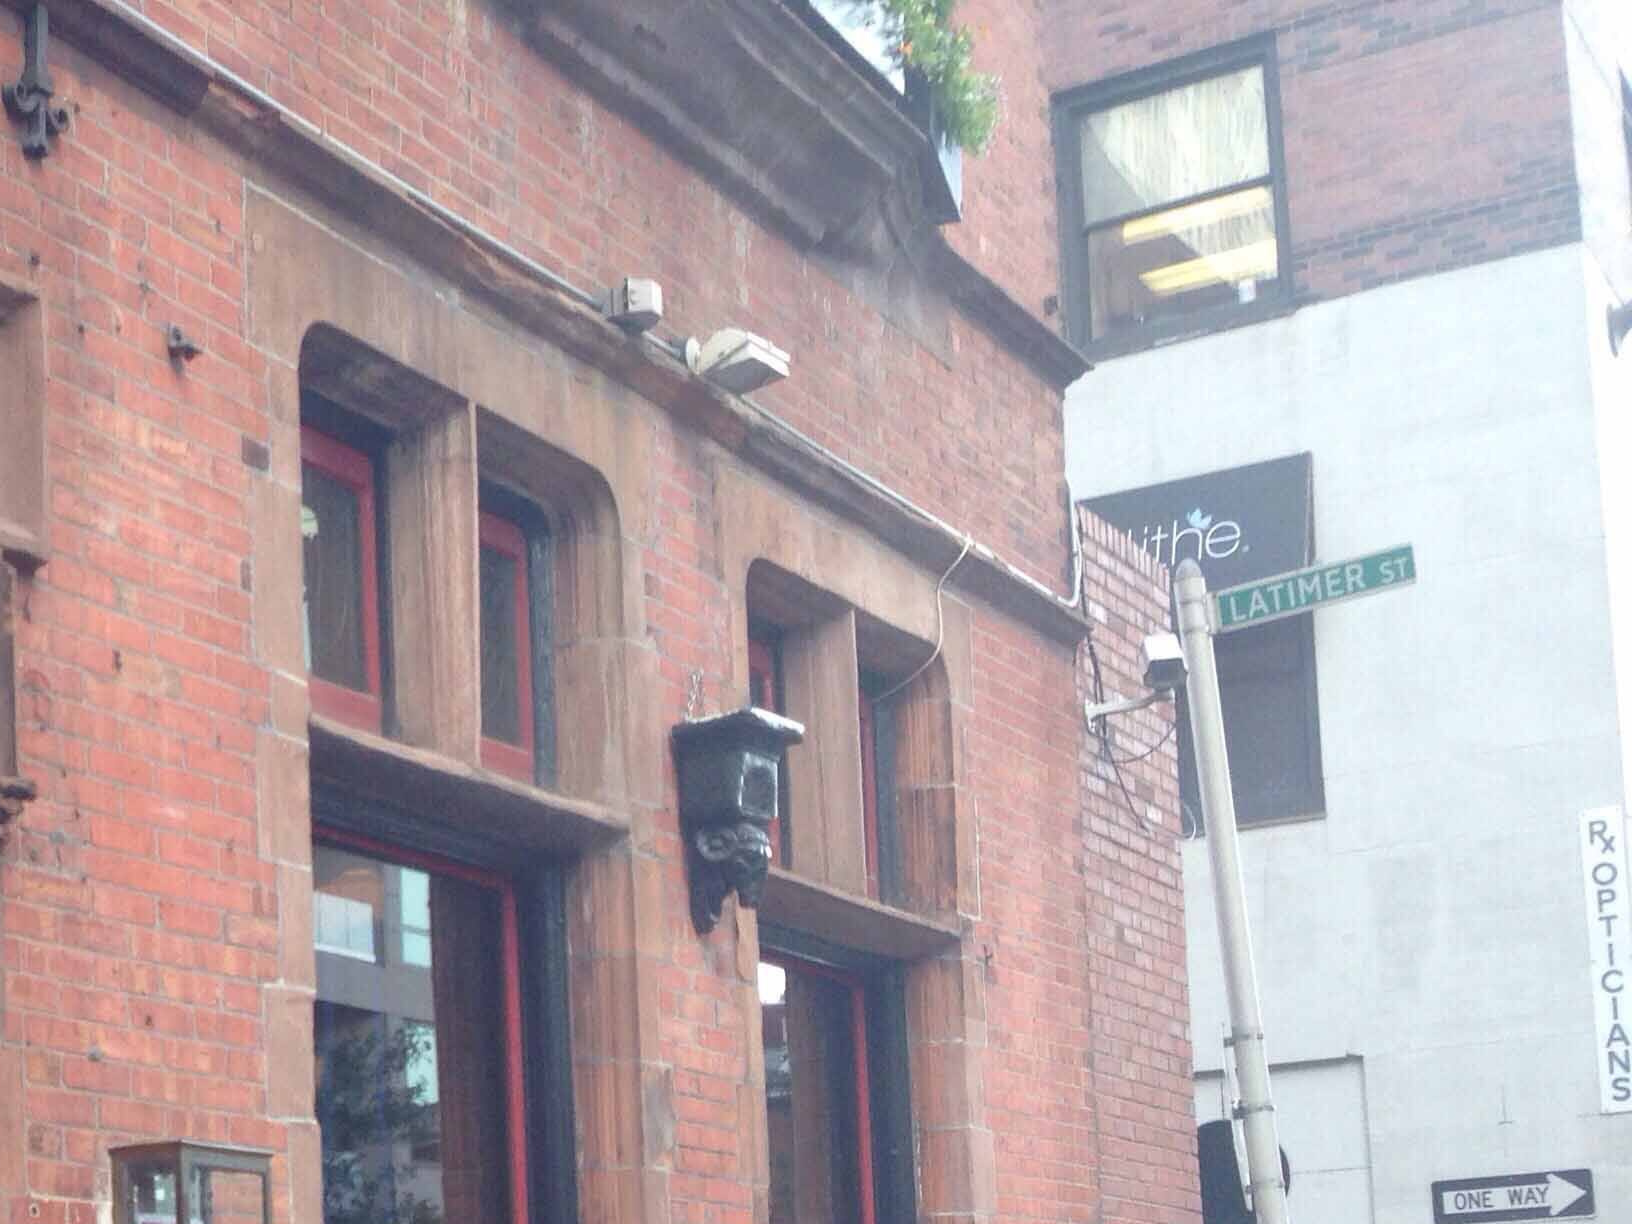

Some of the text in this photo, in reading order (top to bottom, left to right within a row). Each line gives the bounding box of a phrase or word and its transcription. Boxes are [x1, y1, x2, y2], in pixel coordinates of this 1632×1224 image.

[1229, 556, 1410, 622] LATIMER ST
[1592, 862, 1631, 1102] OPTICIANS
[1454, 1186, 1549, 1210] ONE WAY
